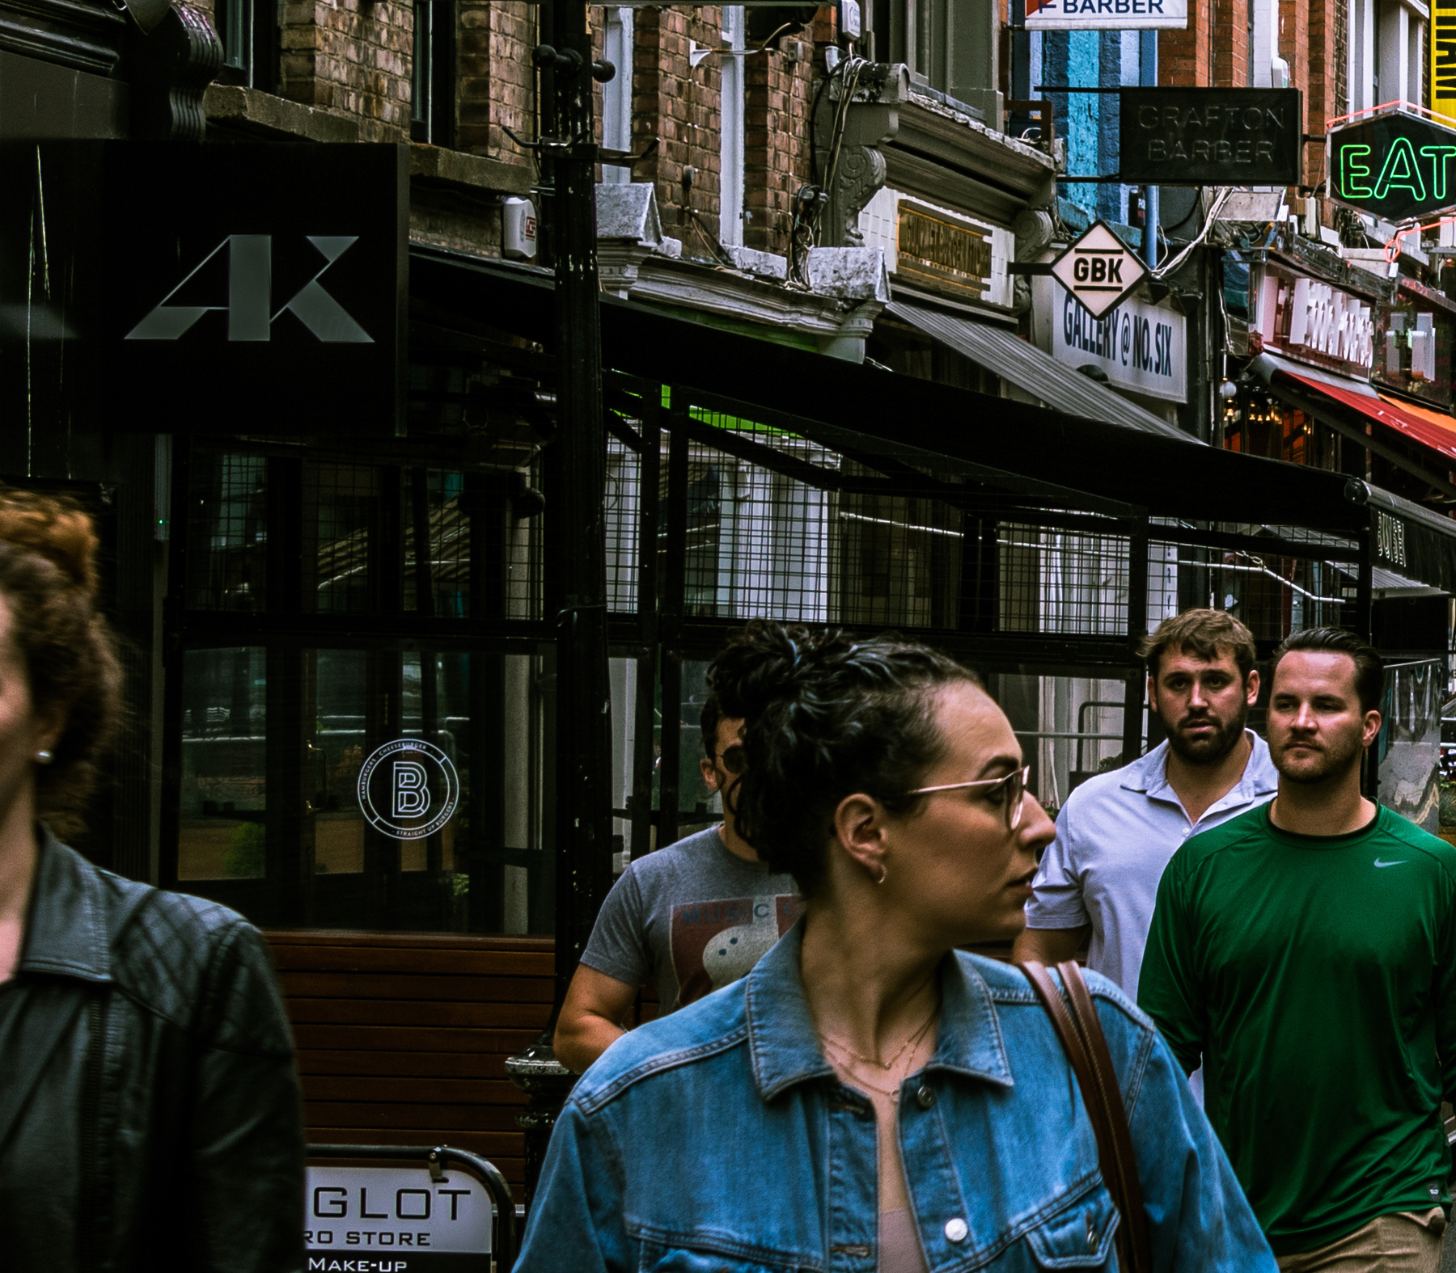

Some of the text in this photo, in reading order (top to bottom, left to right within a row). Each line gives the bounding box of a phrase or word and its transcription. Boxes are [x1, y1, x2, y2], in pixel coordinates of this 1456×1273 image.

[1138, 104, 1284, 129] GRAFTON
[1148, 139, 1273, 164] BARBER
[1073, 257, 1123, 284] GBK
[124, 234, 375, 343] AK
[1120, 325, 1131, 367] @
[1155, 322, 1173, 377] SIX
[392, 761, 431, 818] B
[313, 1186, 472, 1221] GLOT
[346, 1231, 431, 1247] STORE
